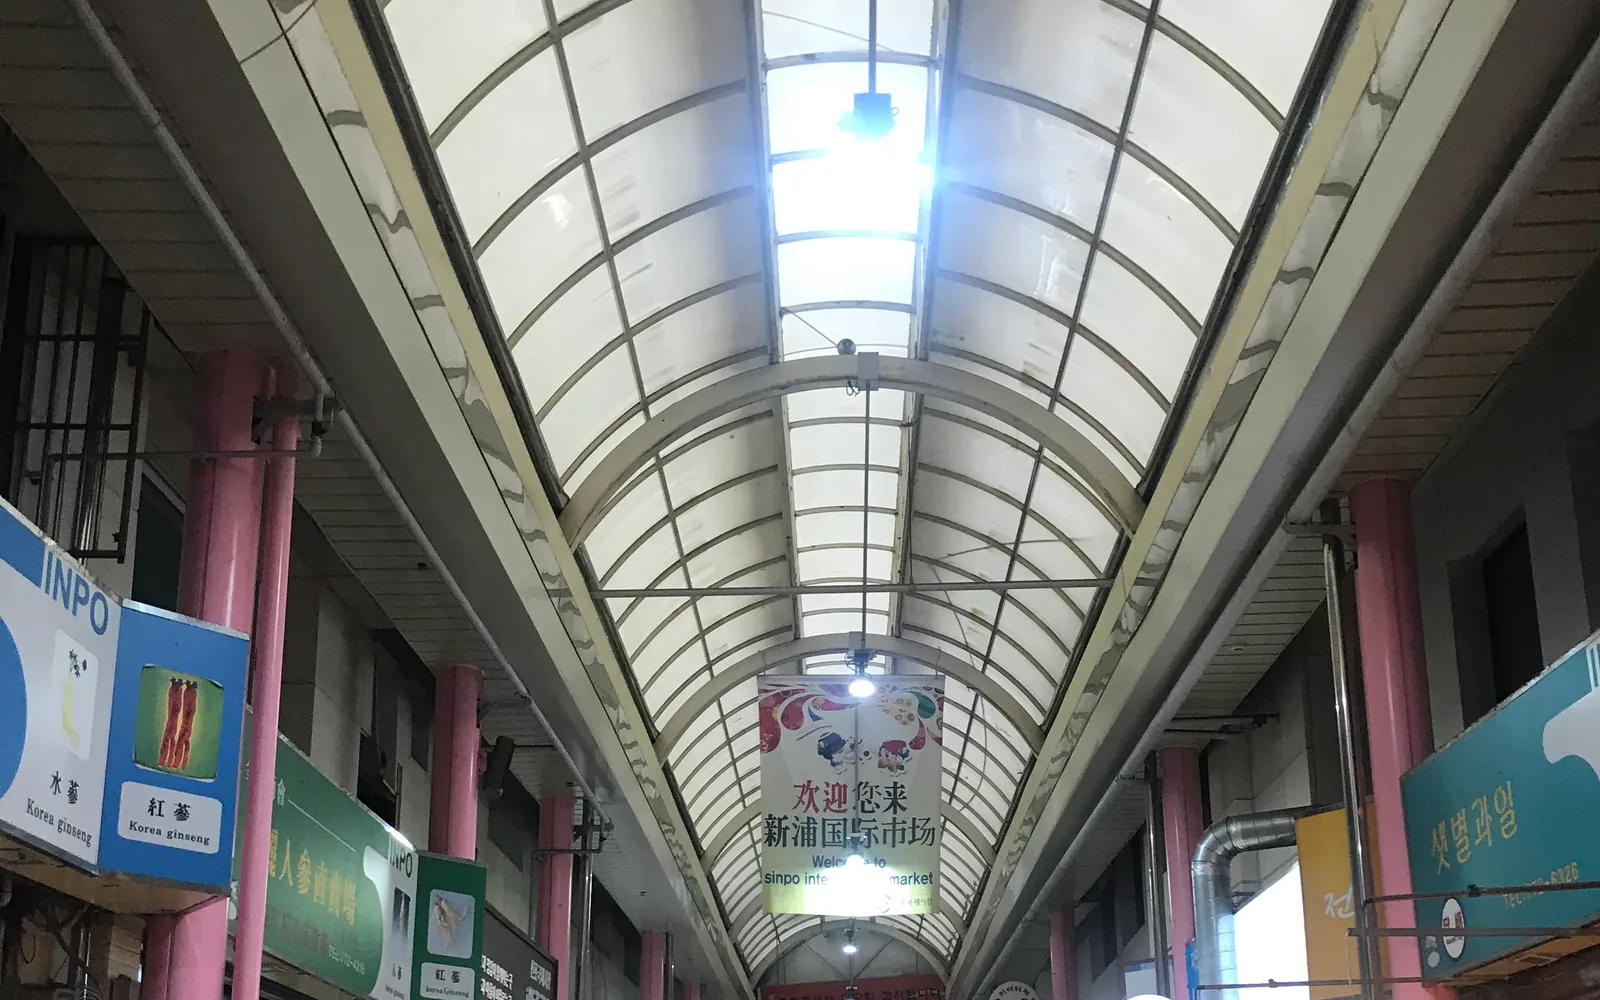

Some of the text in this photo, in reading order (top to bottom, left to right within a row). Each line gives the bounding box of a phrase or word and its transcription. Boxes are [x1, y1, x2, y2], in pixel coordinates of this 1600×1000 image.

[792, 780, 908, 815] 欢迎您来
[26, 798, 92, 848] Korea ginseng
[129, 821, 210, 846] Korea ginseng
[763, 814, 936, 848] 新浦国际市场
[812, 855, 887, 869] Welc to
[764, 871, 800, 886] sinpo
[889, 872, 933, 885] market
